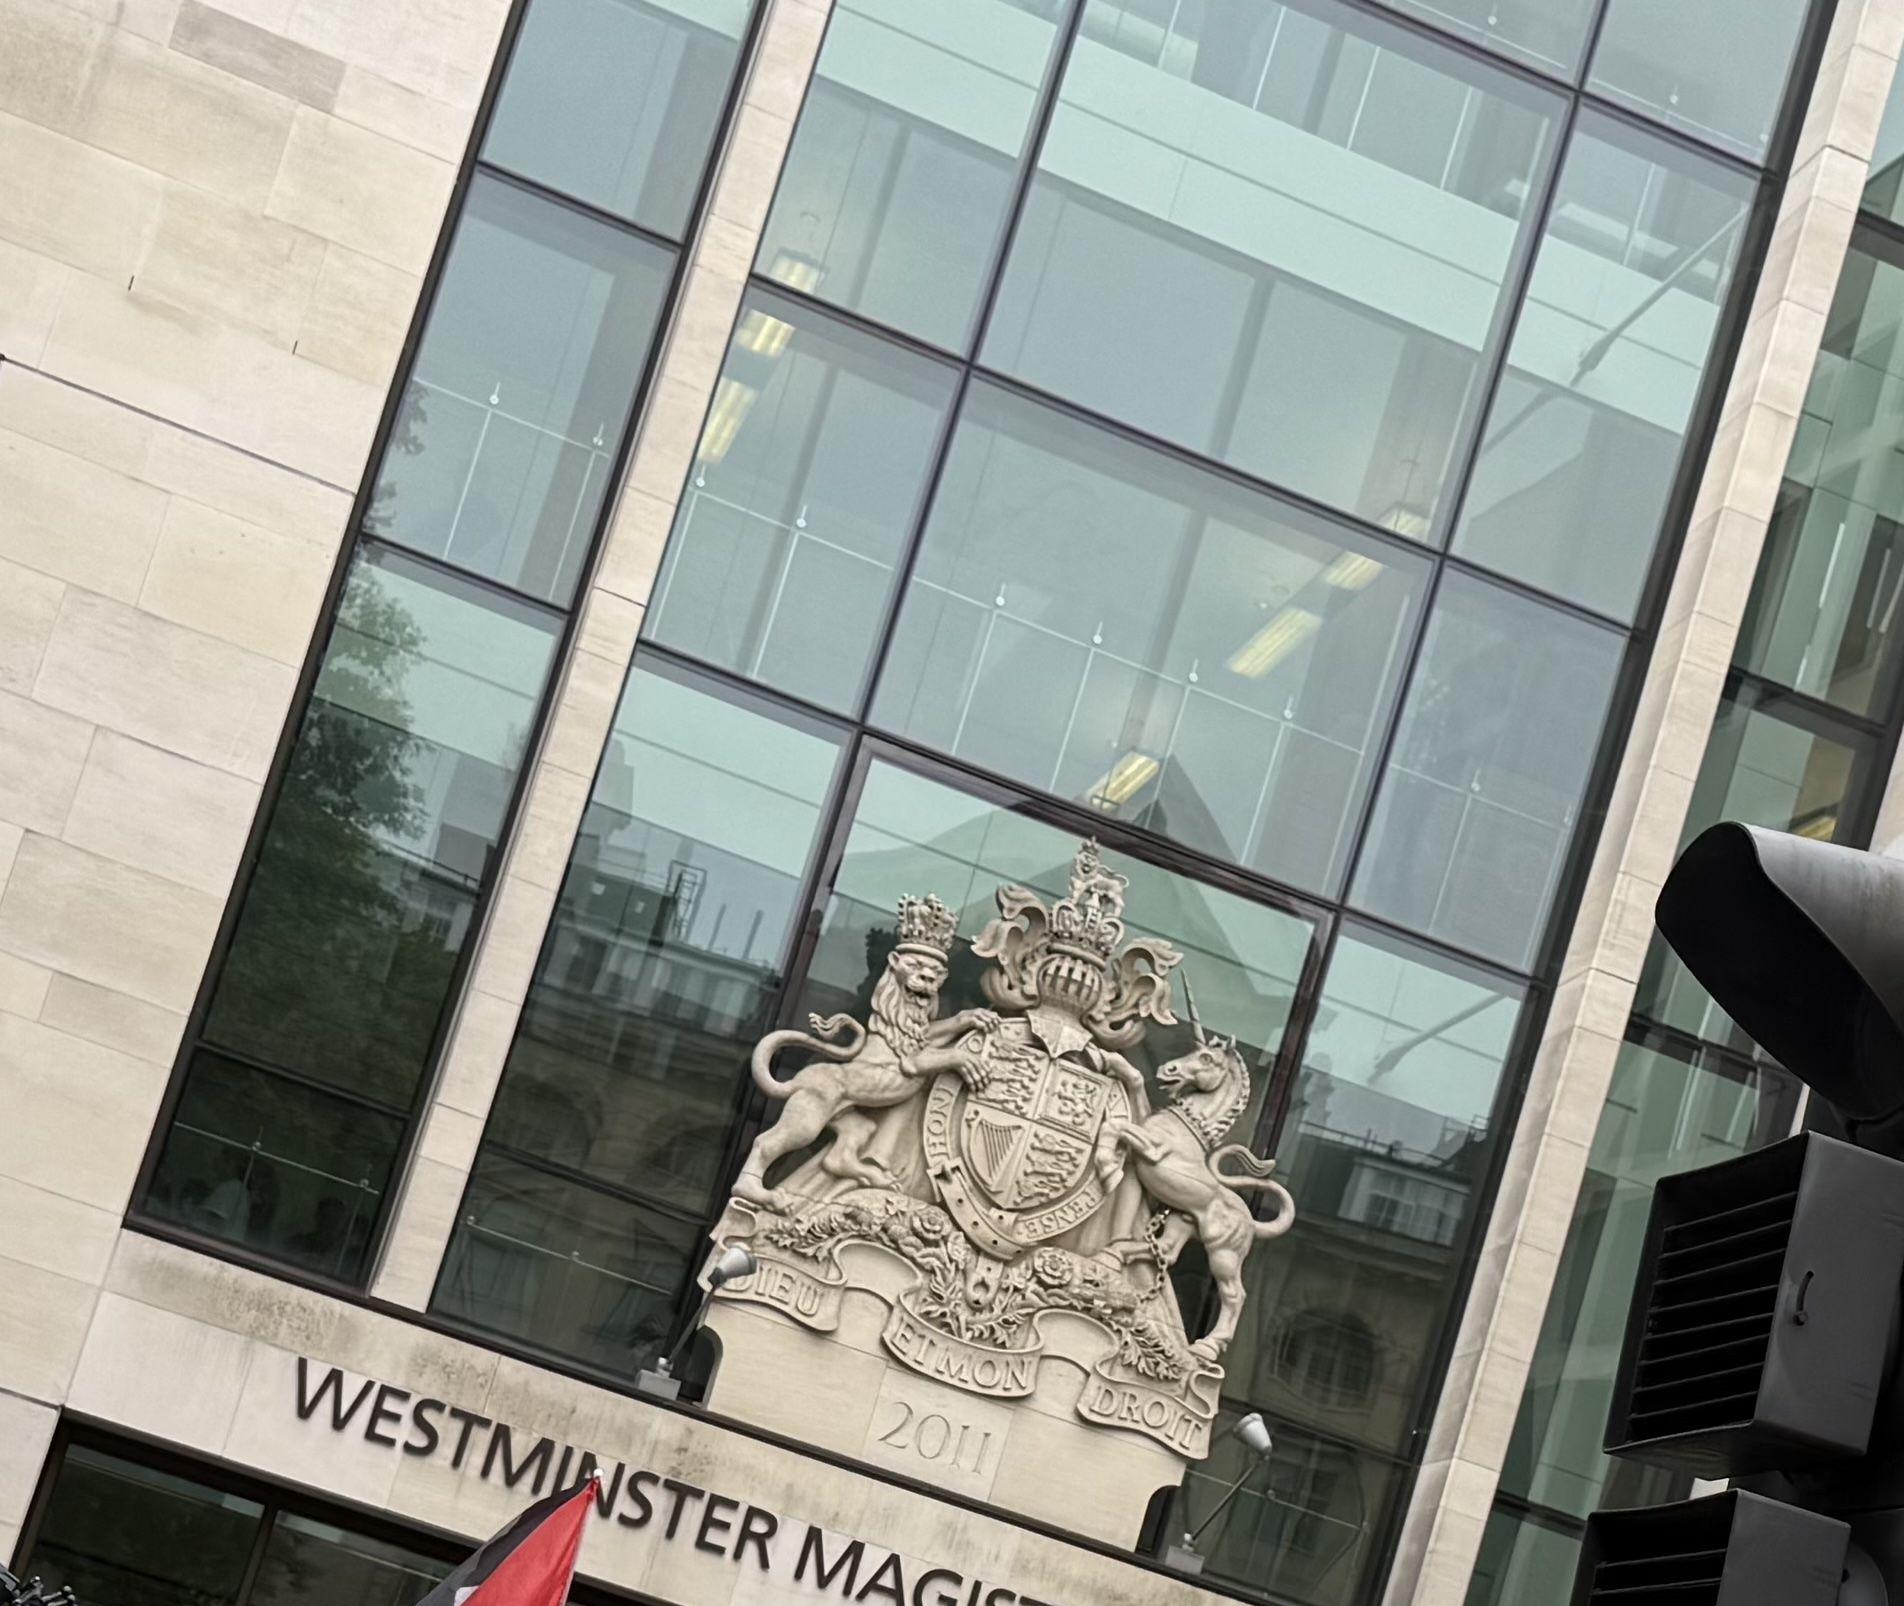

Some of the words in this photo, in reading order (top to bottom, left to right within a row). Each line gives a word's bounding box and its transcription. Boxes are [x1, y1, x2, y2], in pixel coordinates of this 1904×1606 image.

[895, 1320, 936, 1366] ET
[934, 1338, 1035, 1392] MON
[878, 1401, 992, 1476] 2011
[1091, 1383, 1204, 1449] DROIT
[296, 1356, 780, 1571] WESTMINSTER
